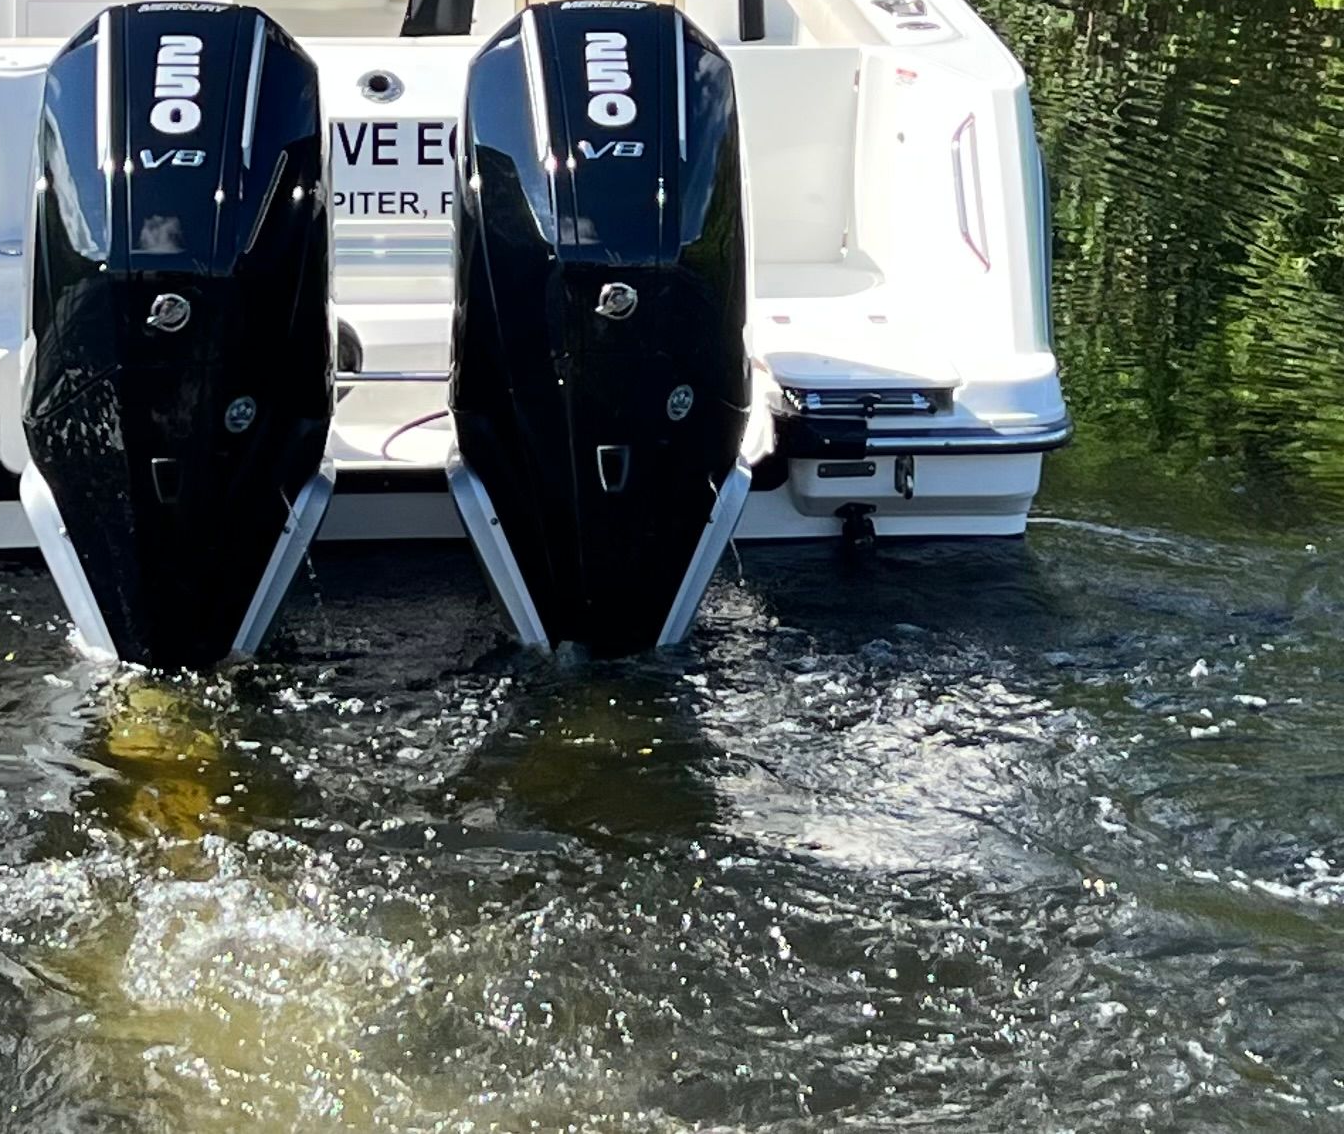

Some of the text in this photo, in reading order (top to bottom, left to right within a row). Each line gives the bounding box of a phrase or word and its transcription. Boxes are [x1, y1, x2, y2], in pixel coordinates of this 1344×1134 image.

[137, 2, 229, 13] MERCURY
[560, 0, 648, 10] MERCURY
[150, 35, 203, 134] 250
[584, 32, 637, 126] 250
[140, 149, 206, 168] V8
[578, 140, 645, 159] V8
